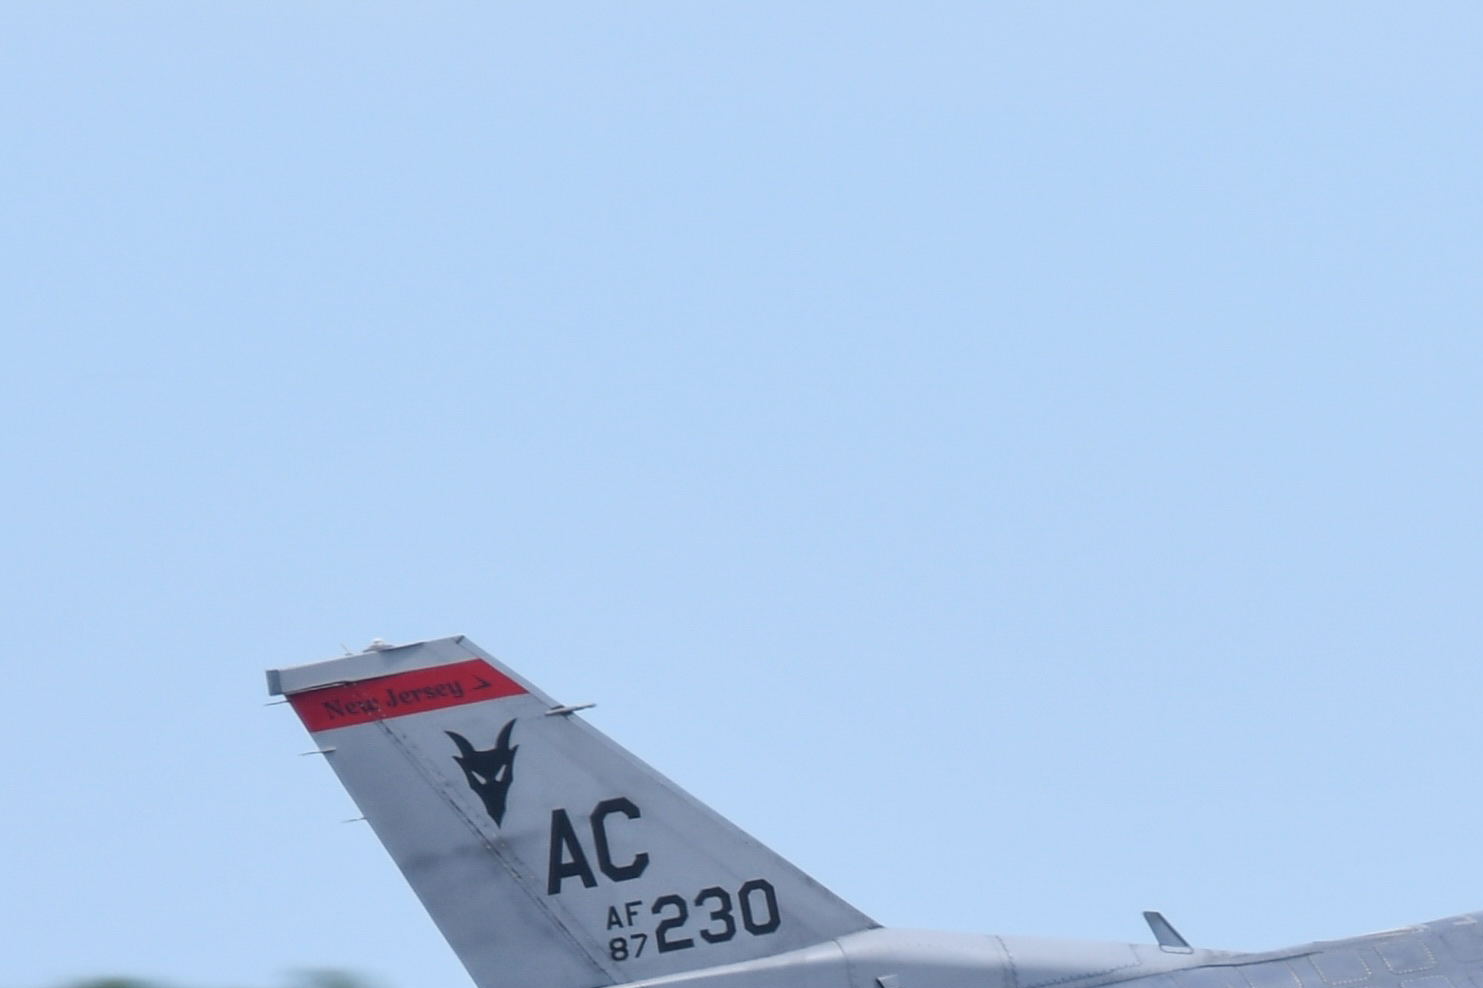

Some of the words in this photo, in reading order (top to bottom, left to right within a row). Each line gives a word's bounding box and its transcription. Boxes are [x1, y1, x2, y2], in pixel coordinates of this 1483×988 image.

[322, 697, 379, 720] New
[386, 680, 465, 708] Jersey
[548, 796, 649, 896] AC
[606, 900, 643, 930] AF
[651, 878, 781, 954] 230
[609, 933, 648, 962] 87
